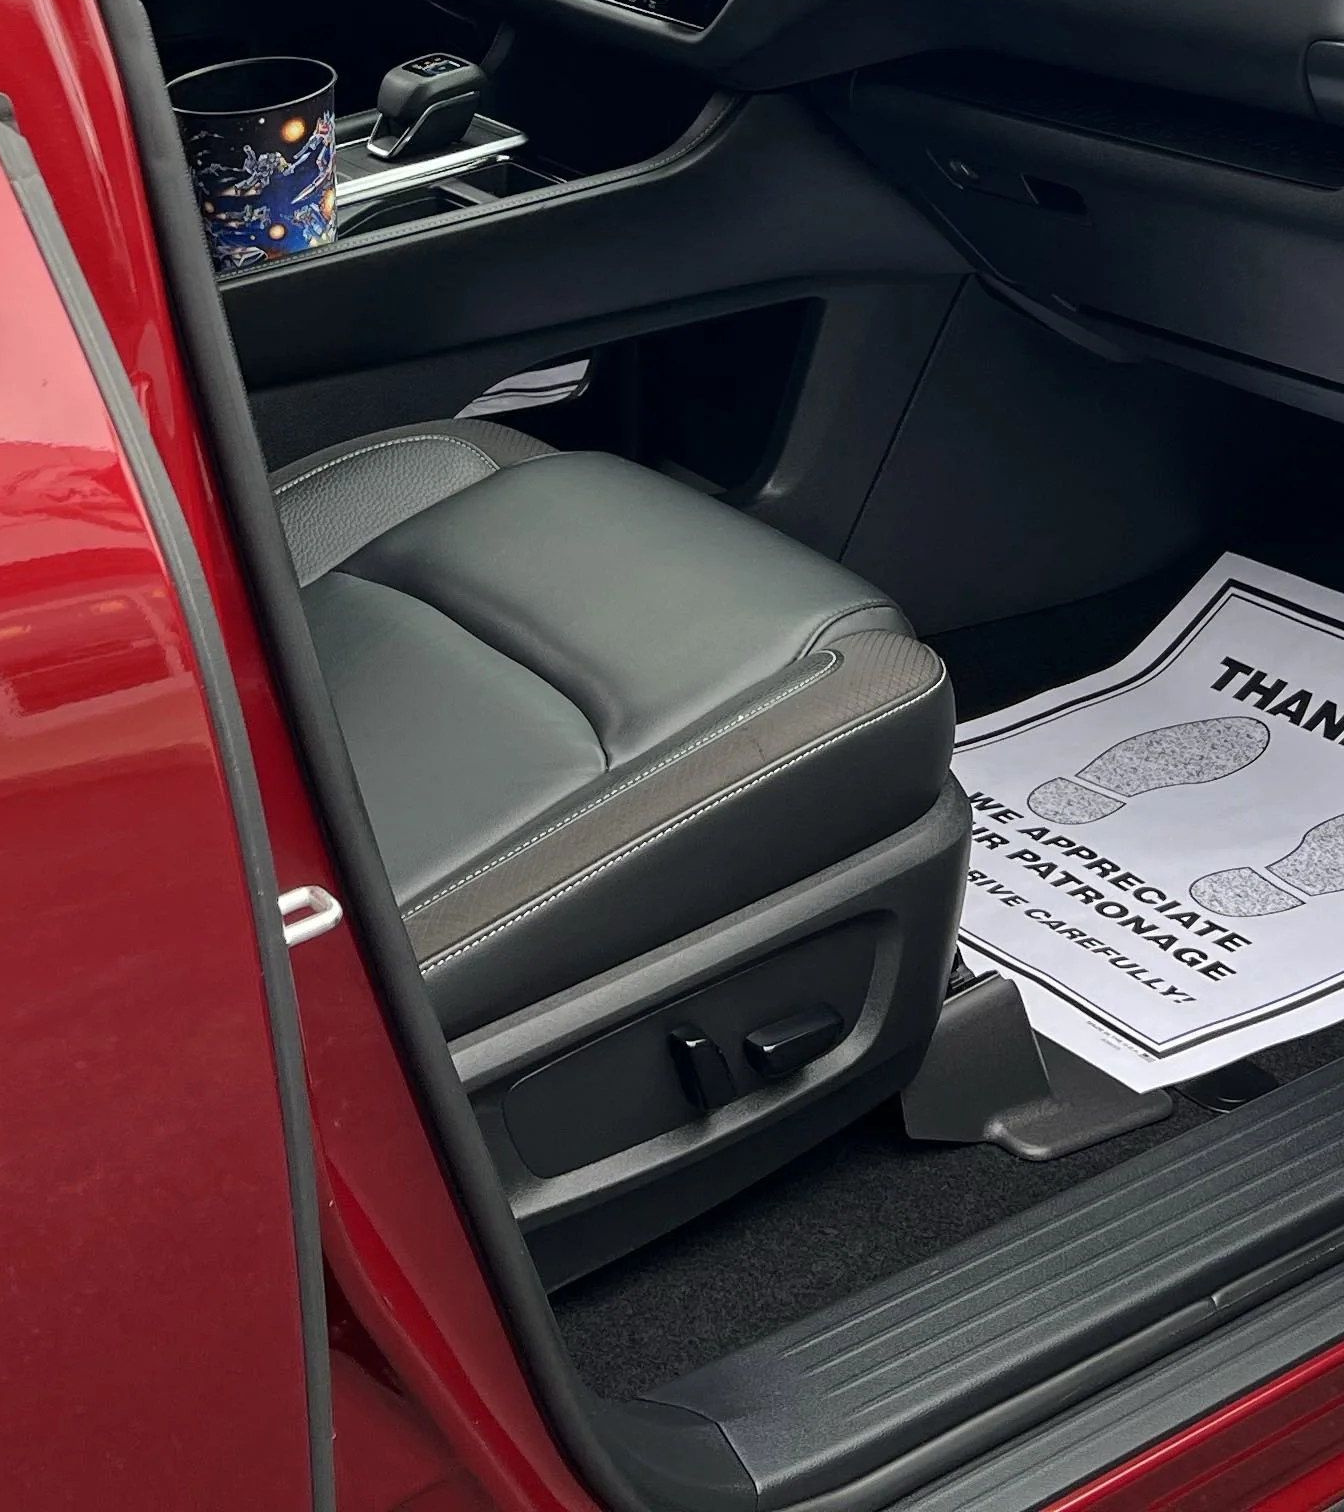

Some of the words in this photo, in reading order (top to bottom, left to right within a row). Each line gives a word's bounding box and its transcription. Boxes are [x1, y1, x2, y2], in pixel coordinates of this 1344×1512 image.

[967, 869, 1030, 907] RIVE
[1024, 908, 1197, 1003] CAREFULLY!
[968, 791, 1024, 825] WE
[1016, 826, 1253, 953] APPRECIATE
[1005, 848, 1237, 982] PATRONAGE
